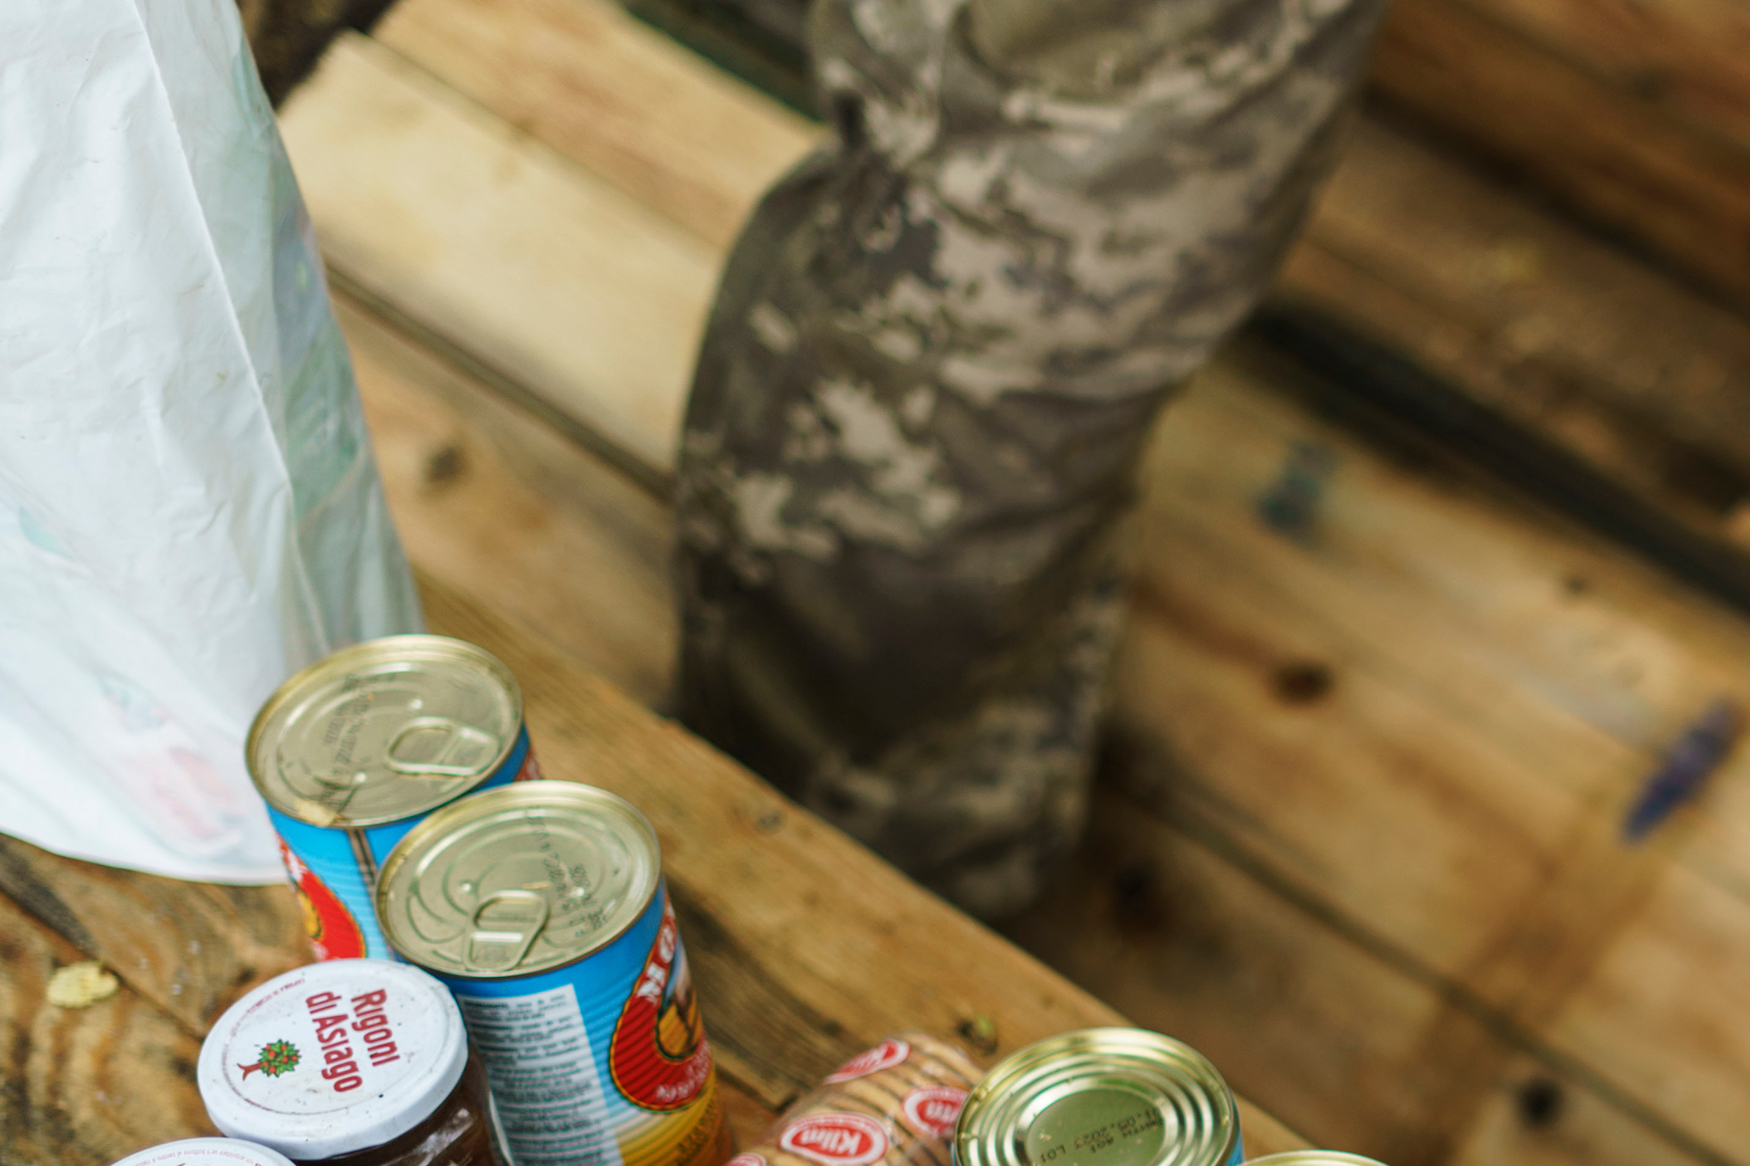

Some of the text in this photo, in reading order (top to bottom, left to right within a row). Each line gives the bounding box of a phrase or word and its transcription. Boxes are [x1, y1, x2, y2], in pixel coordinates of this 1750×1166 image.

[305, 989, 363, 1091] di Asiago
[350, 988, 400, 1067] Rigoni
[799, 1129, 861, 1155] Klim
